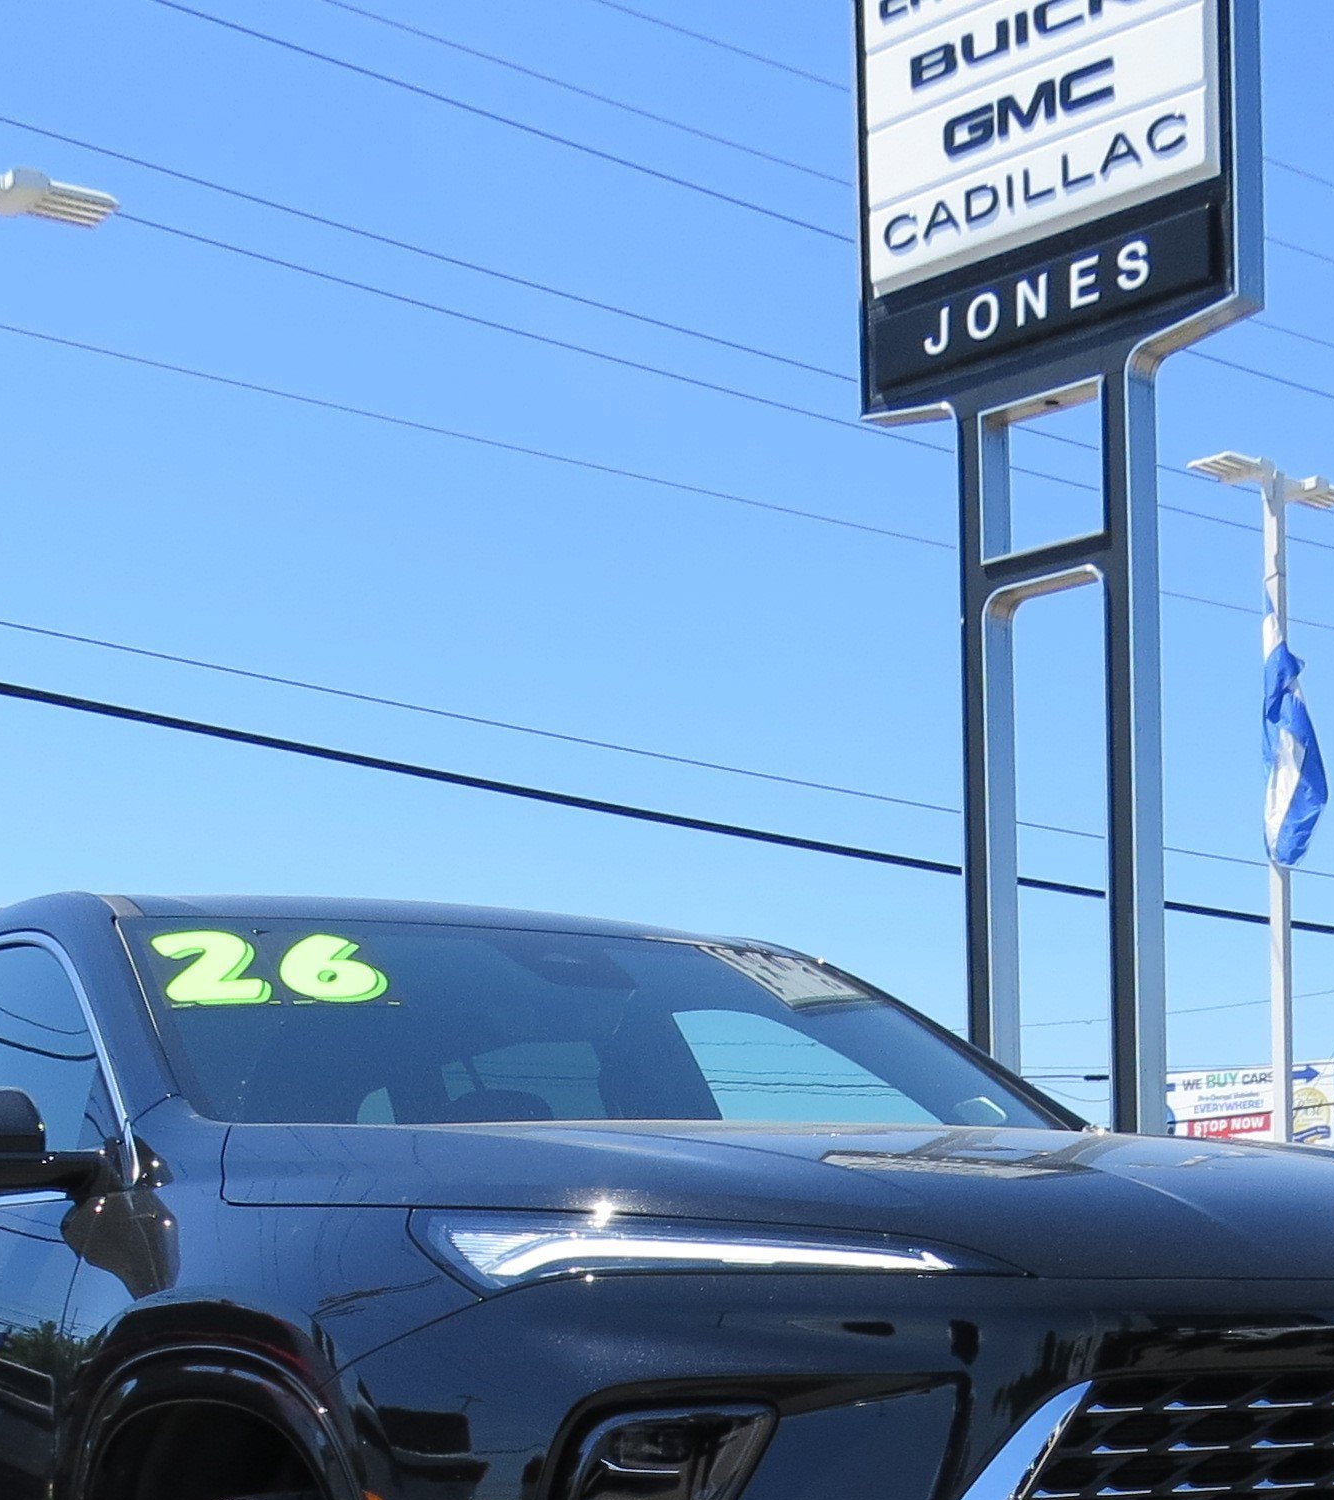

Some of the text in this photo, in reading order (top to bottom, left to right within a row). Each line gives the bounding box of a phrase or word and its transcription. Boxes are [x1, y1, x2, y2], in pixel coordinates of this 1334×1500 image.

[943, 57, 1115, 158] GMC
[883, 112, 1188, 251] CADILLAC
[923, 239, 1151, 356] JONES
[150, 929, 389, 1006] 26
[1182, 1079, 1202, 1091] WE
[1206, 1072, 1239, 1088] BUY
[1193, 1115, 1265, 1132] STOP NOW
